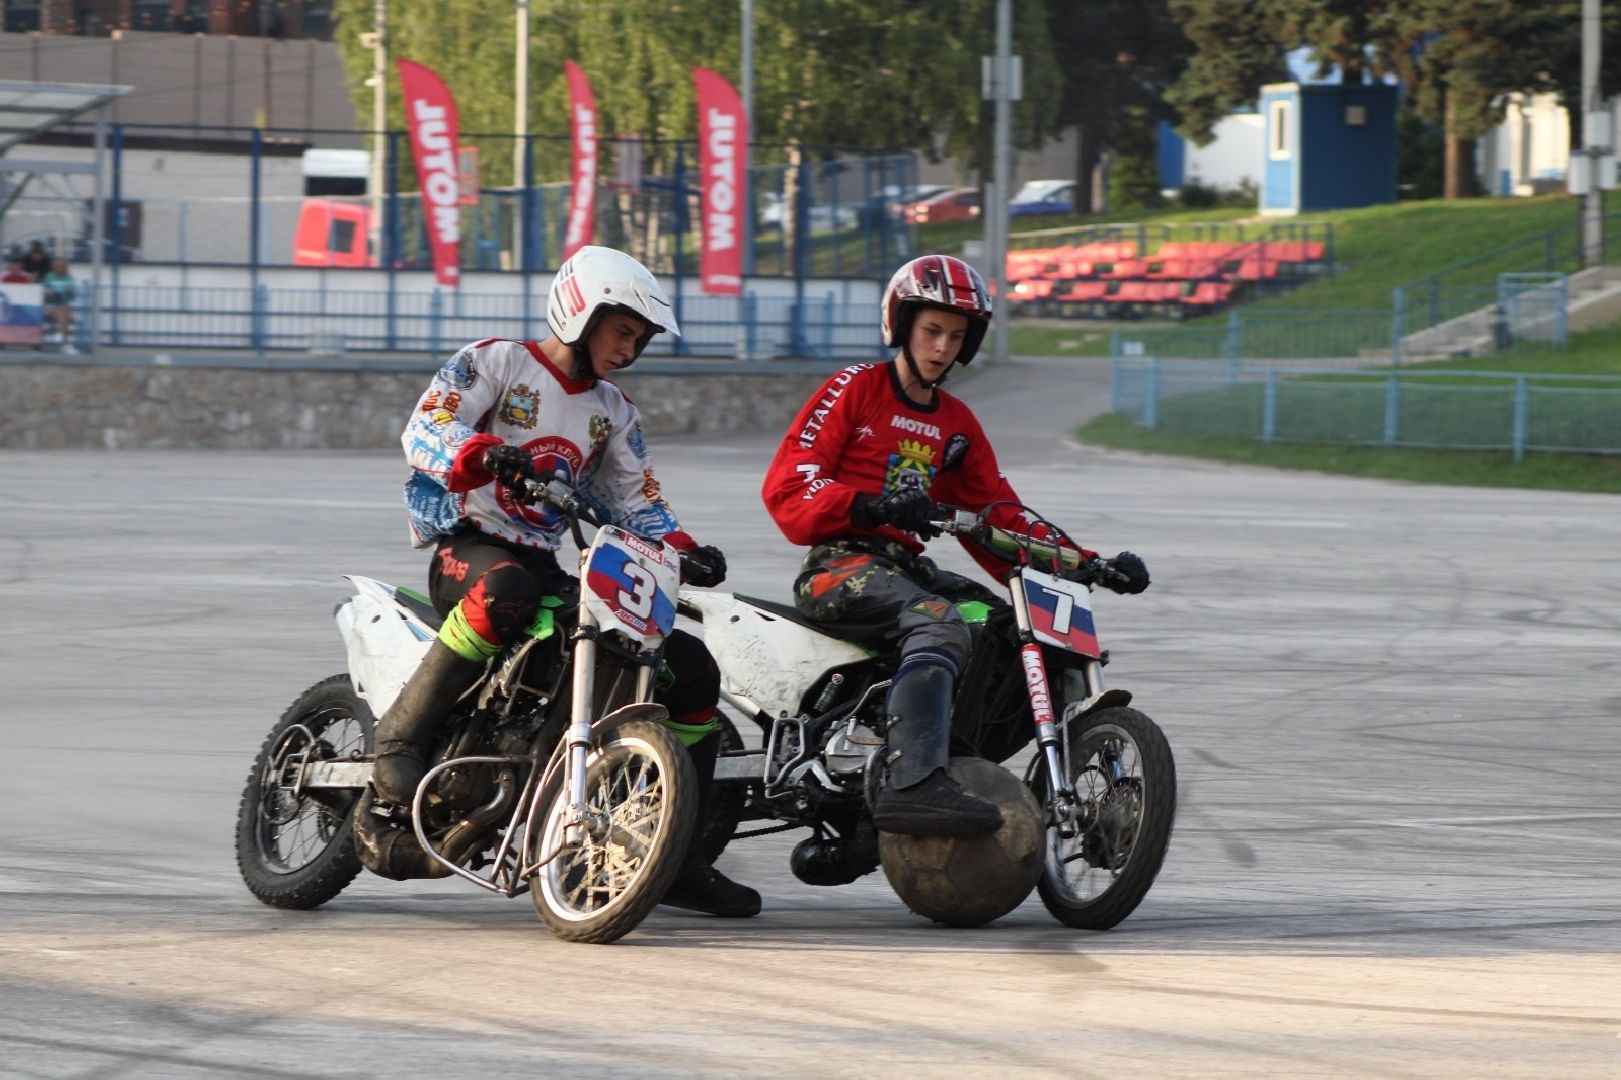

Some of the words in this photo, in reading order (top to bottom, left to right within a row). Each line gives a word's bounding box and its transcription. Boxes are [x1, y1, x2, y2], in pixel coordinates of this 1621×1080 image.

[891, 415, 941, 440] MOTUL
[627, 537, 661, 563] MOTUL
[618, 561, 656, 619] 3
[1042, 587, 1074, 635] 7
[1022, 651, 1050, 720] MOTUL
